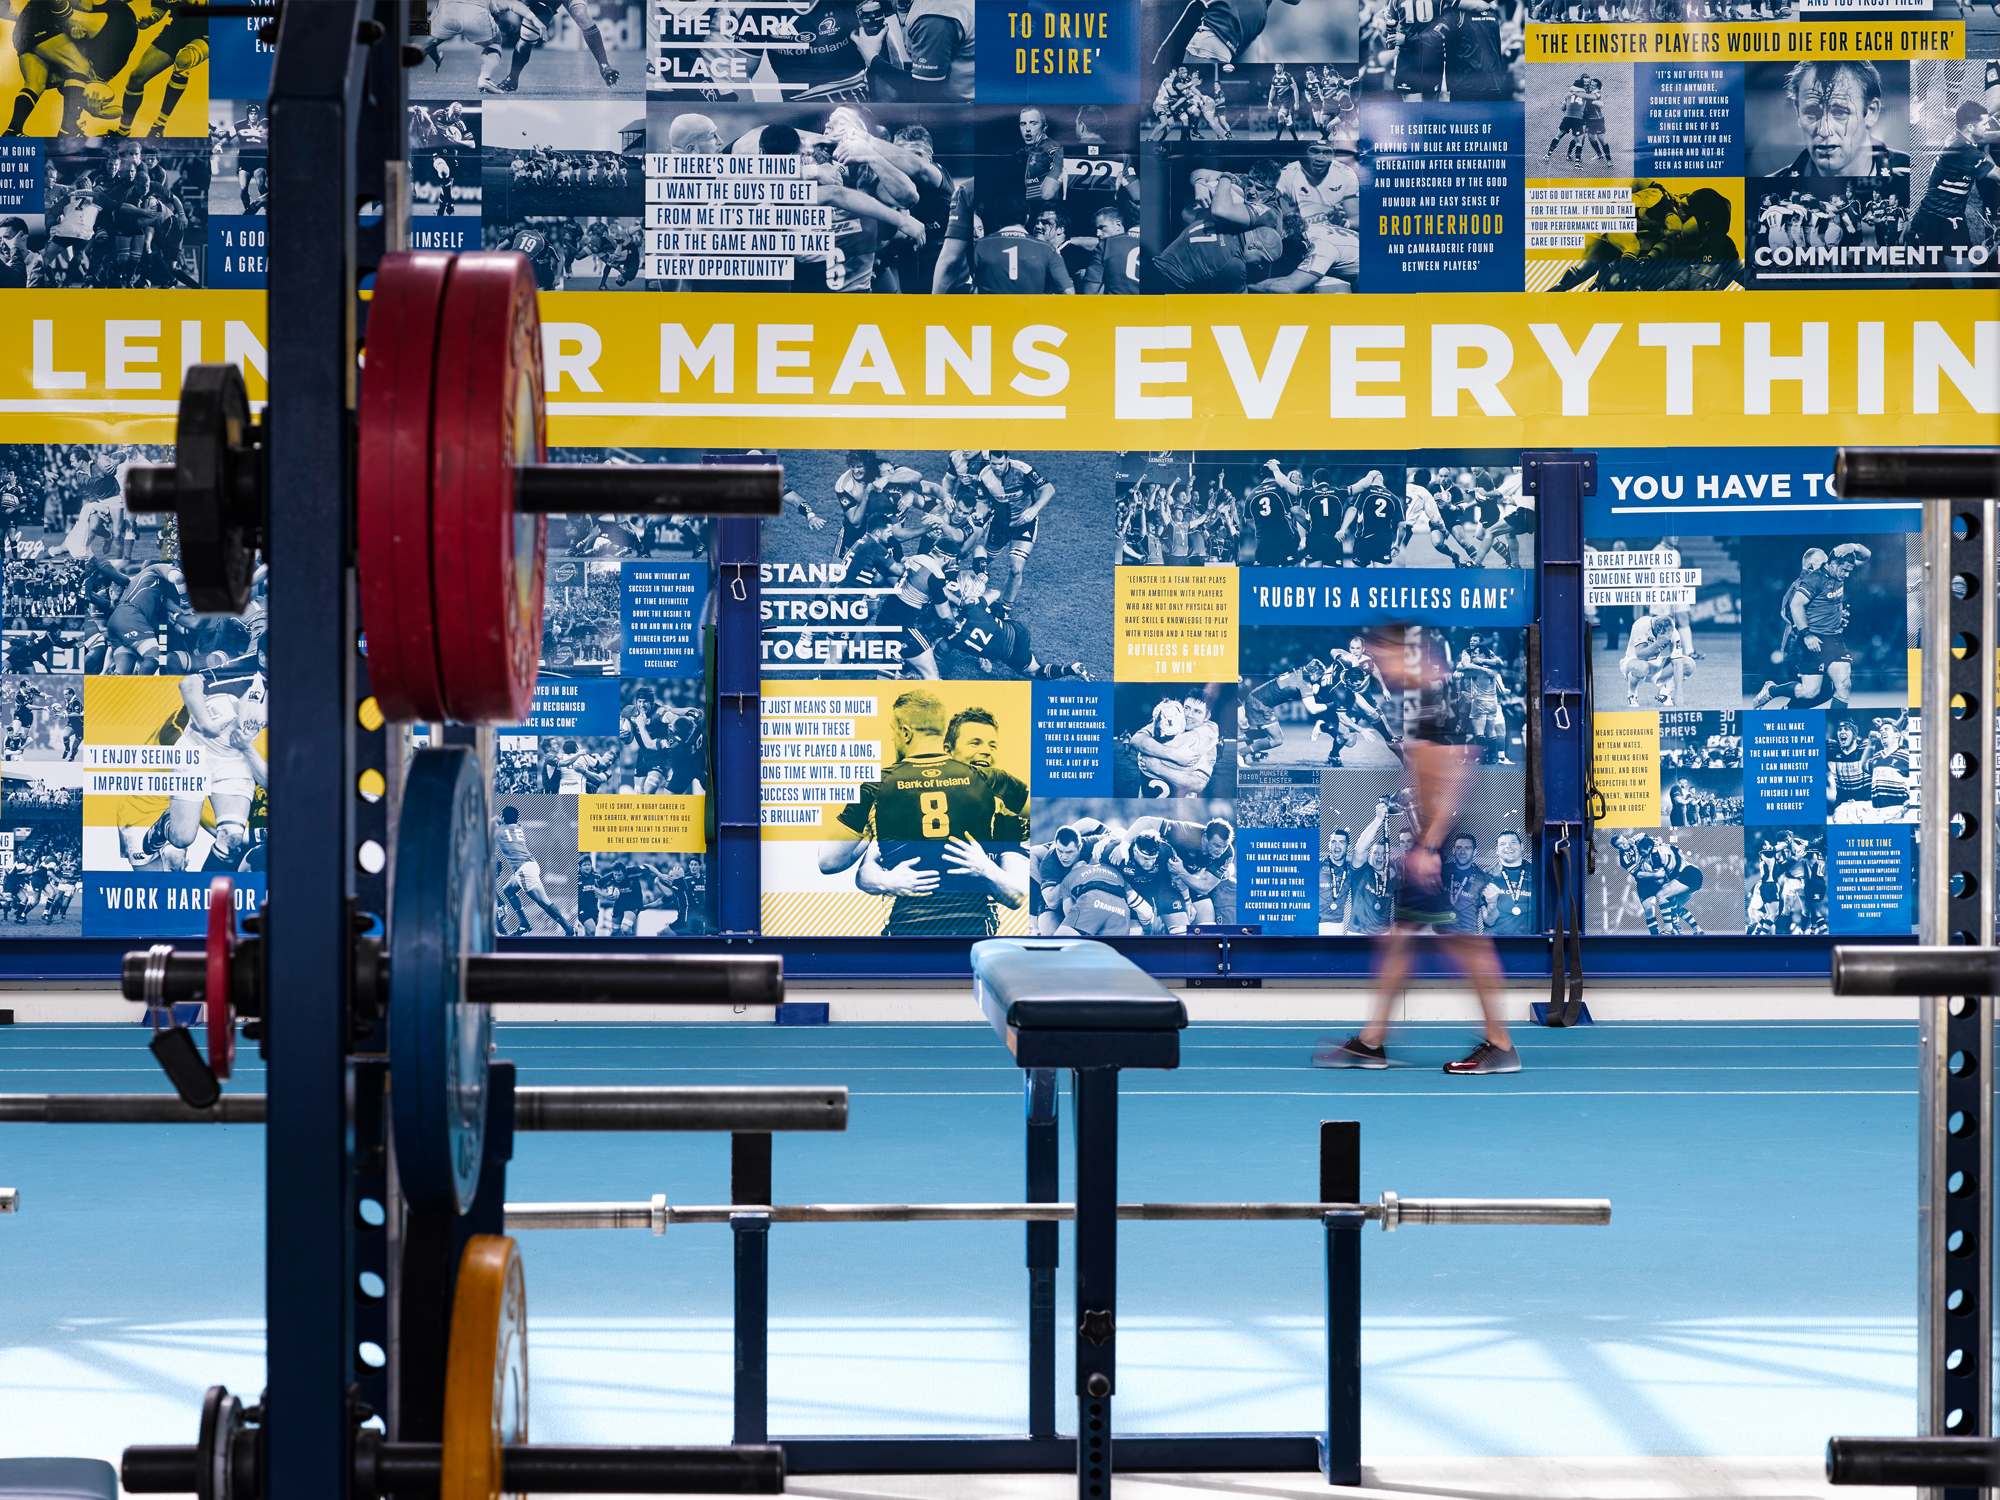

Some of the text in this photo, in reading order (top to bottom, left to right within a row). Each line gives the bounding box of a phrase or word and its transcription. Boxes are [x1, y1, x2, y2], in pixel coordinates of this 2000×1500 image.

[654, 15, 800, 36] THE DARK
[1008, 12, 1107, 39] TO DRIVE
[1536, 31, 1954, 53] 'THE LEINSTER PLAYERS WOULD DIE FOR EACH OTHER'
[654, 57, 748, 78] PLACE
[1016, 48, 1101, 74] DESIRE'
[1661, 83, 1717, 92] SEE IT ANYMORE,
[1650, 109, 1729, 118] FOR EACH OTHER. EVERY
[1391, 124, 1492, 135] THE ESOTERIC VALUES OF
[653, 157, 795, 175] 'IF THERE'S ONE THING
[1077, 161, 1113, 190] 22
[1379, 214, 1503, 236] BROTHERHOOD
[1531, 236, 1584, 246] CARE OF ITSELF'
[1754, 245, 1989, 266] COMMITMENT TO
[657, 259, 788, 276] EVERY OPPORTUNITY'
[1402, 260, 1480, 272] BETWEEN PLAYERS'
[660, 322, 1071, 396] MEANS
[1610, 475, 1684, 500] YOU
[1696, 473, 1792, 499] HAVE
[1259, 497, 1272, 516] 3
[1320, 498, 1328, 516] 1
[1375, 499, 1387, 518] 2
[1585, 553, 1673, 567] 'A GREAT PLAYER IS
[760, 563, 847, 583] STAND
[1588, 572, 1696, 585] SOMEONE WHO GETS UP
[675, 585, 694, 593] PERIOD
[1130, 589, 1223, 597] WITH AMBITION WITH PLAYERS
[1253, 586, 1514, 609] 'RUGBY IS A SELFLESS GAME'
[1589, 590, 1689, 604] EVEN WHEN HE CAN'T'
[760, 600, 869, 620] STRONG
[662, 635, 676, 643] CUPS
[760, 639, 903, 660] TOGETHER
[1128, 643, 1225, 656] RUTHLESS & READY
[644, 660, 678, 668] EXCELLENCE'
[1155, 661, 1196, 674] TO WIN'
[551, 686, 560, 696] IN
[561, 686, 579, 696] BLUE
[543, 702, 585, 712] RECOGNISED
[1077, 696, 1083, 704] TO
[1085, 696, 1098, 704] PLAY
[1056, 721, 1067, 729] NOT
[1068, 721, 1107, 729] MERCENARIES.
[1595, 728, 1653, 737] MEANS ENCOURAGING
[1755, 736, 1789, 744] SACRIFICES
[90, 749, 199, 765] 'I ENJOY SEEING US
[1766, 763, 1777, 771] CAN
[1780, 762, 1809, 770] HONESTLY
[94, 776, 207, 791] IMPROVE TOGETHER'
[896, 776, 971, 790] Bank of Ireland
[802, 788, 826, 801] WITH
[829, 788, 854, 801] THEM
[770, 809, 819, 823] BRILLIANT'
[920, 791, 950, 838] 8
[99, 887, 158, 910] 'WORK
